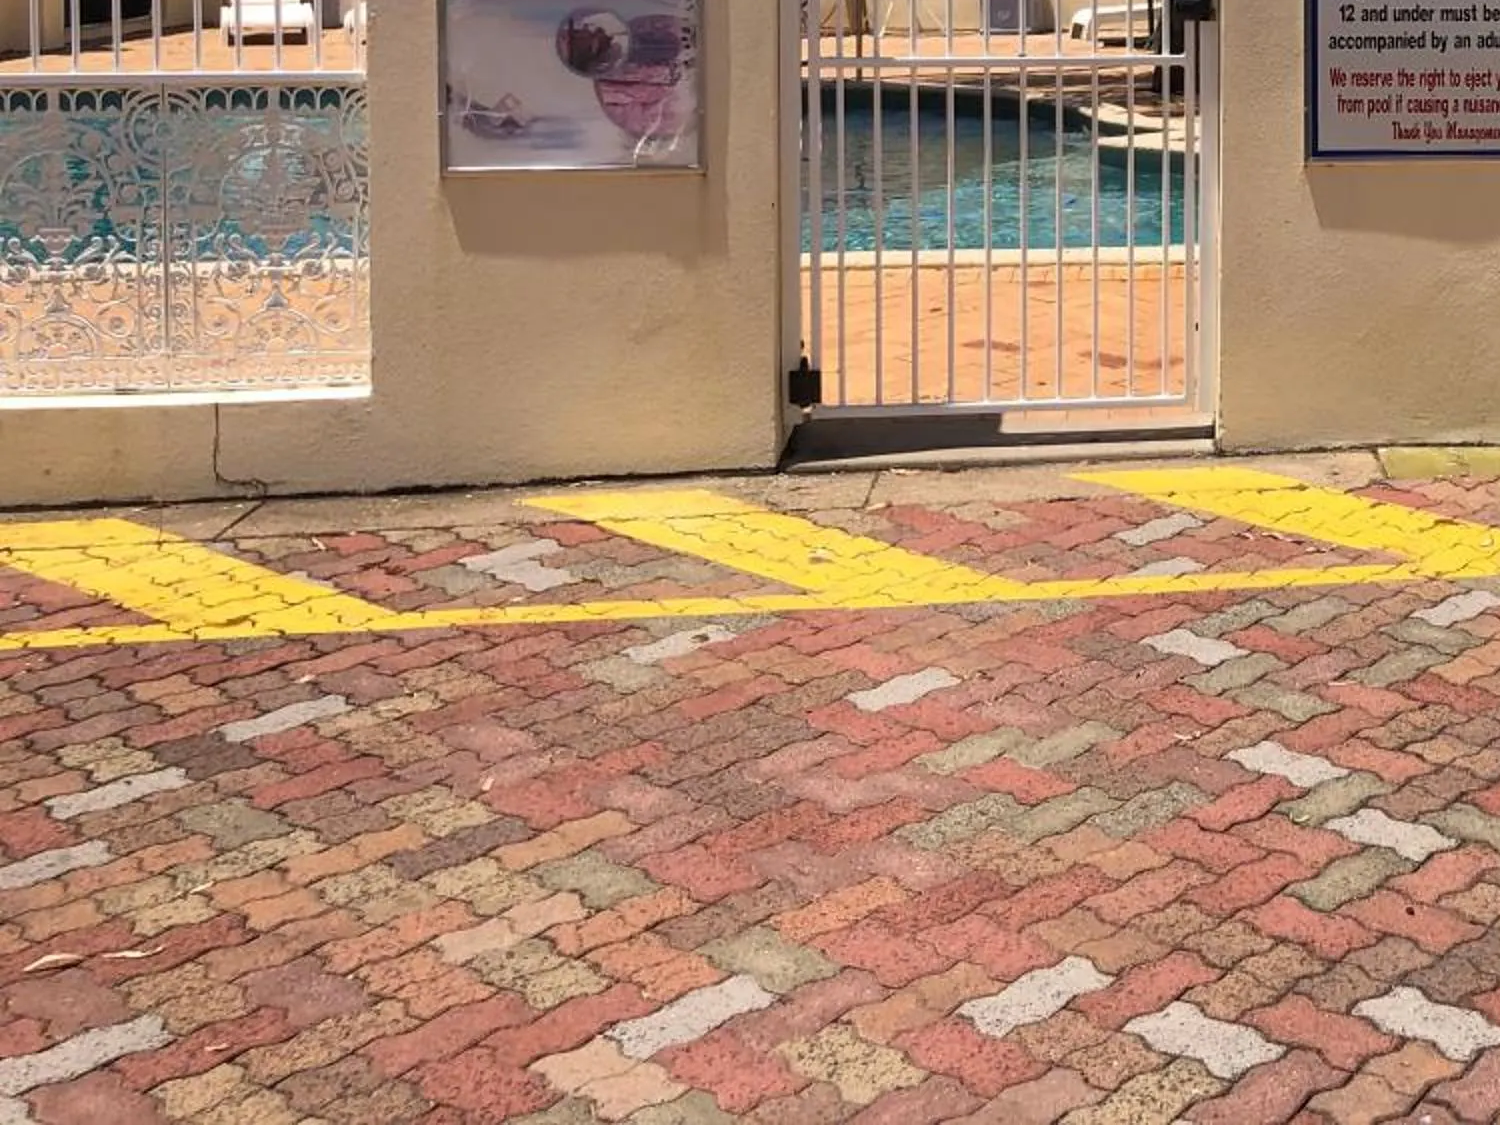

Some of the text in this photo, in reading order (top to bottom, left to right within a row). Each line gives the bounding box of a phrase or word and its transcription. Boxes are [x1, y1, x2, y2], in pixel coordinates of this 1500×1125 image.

[1339, 4, 1500, 22] 12 and under must be
[1328, 31, 1426, 52] accompanied
[1431, 31, 1448, 53] by
[1454, 36, 1471, 49] an
[1329, 67, 1346, 88] We
[1351, 72, 1393, 88] reserve
[1397, 68, 1415, 88] the
[1419, 68, 1445, 91] right
[1450, 69, 1461, 88] to
[1464, 68, 1492, 91] eject
[1337, 95, 1364, 114] from
[1367, 95, 1392, 118] pool
[1395, 95, 1403, 114] if
[1407, 96, 1449, 117] causing
[1452, 99, 1459, 114] a
